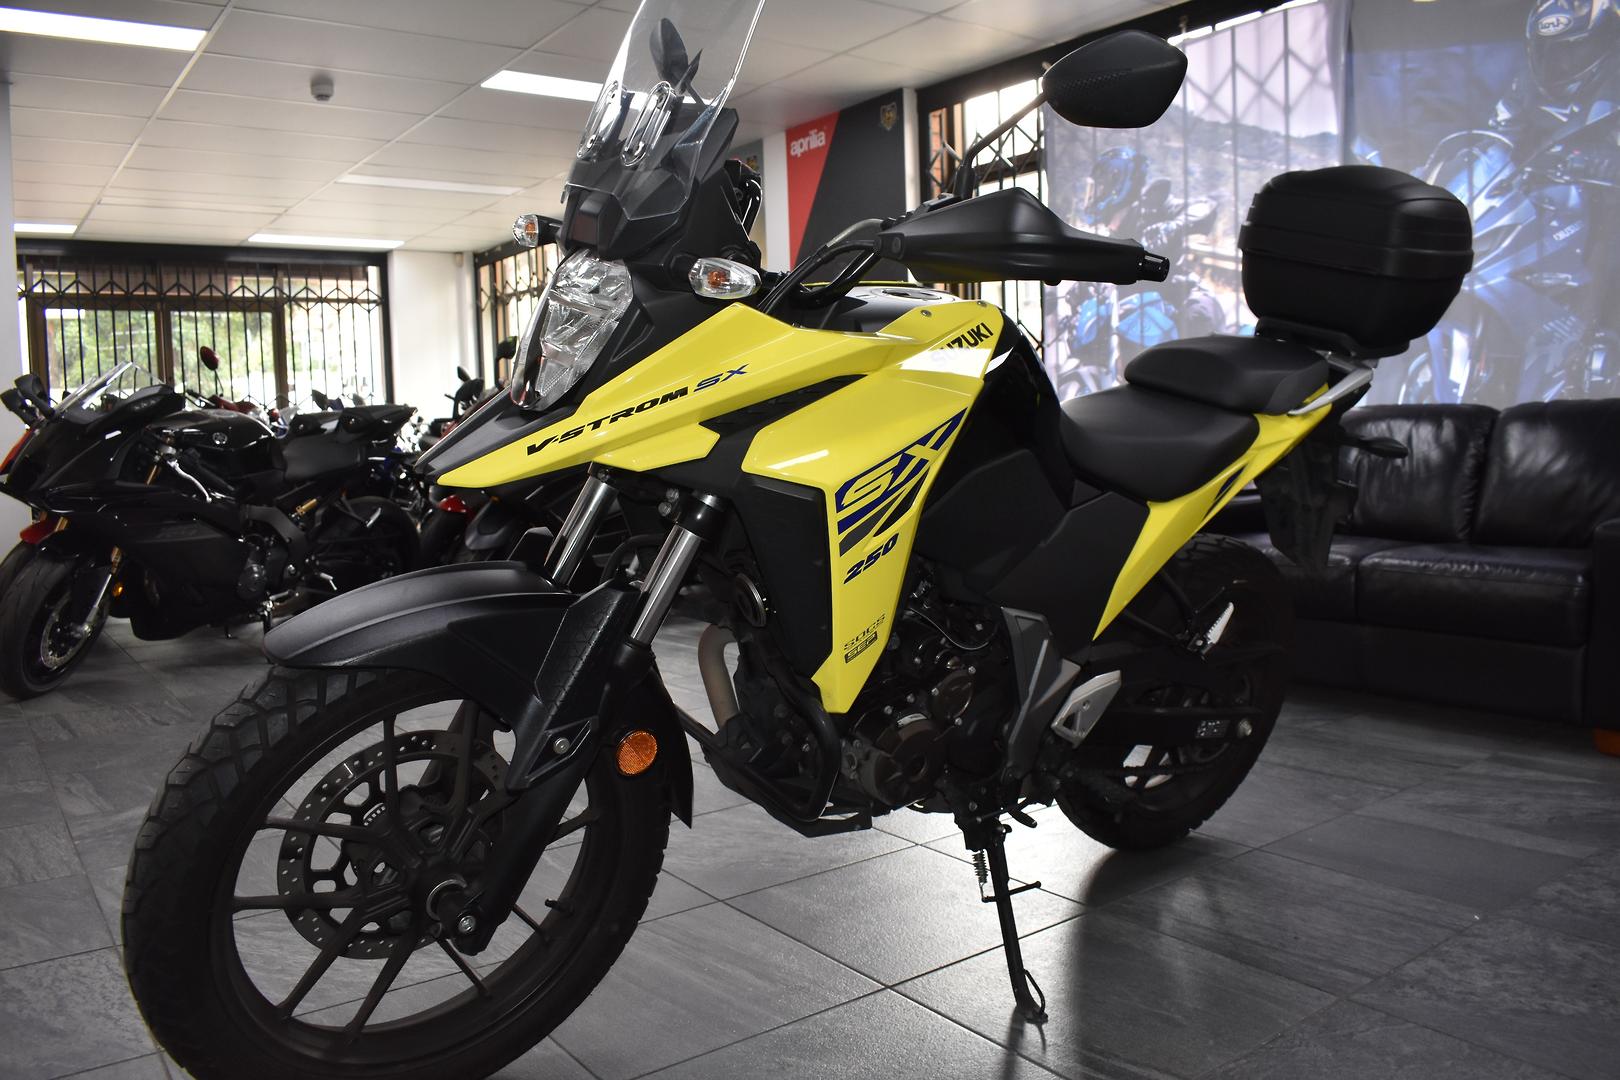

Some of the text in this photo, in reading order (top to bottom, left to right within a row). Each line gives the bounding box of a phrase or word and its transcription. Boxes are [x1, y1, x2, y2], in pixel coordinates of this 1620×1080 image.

[790, 128, 826, 157] aprilia
[932, 322, 994, 362] ZUKI
[526, 363, 750, 456] V-STROM SX
[843, 532, 900, 585] 250
